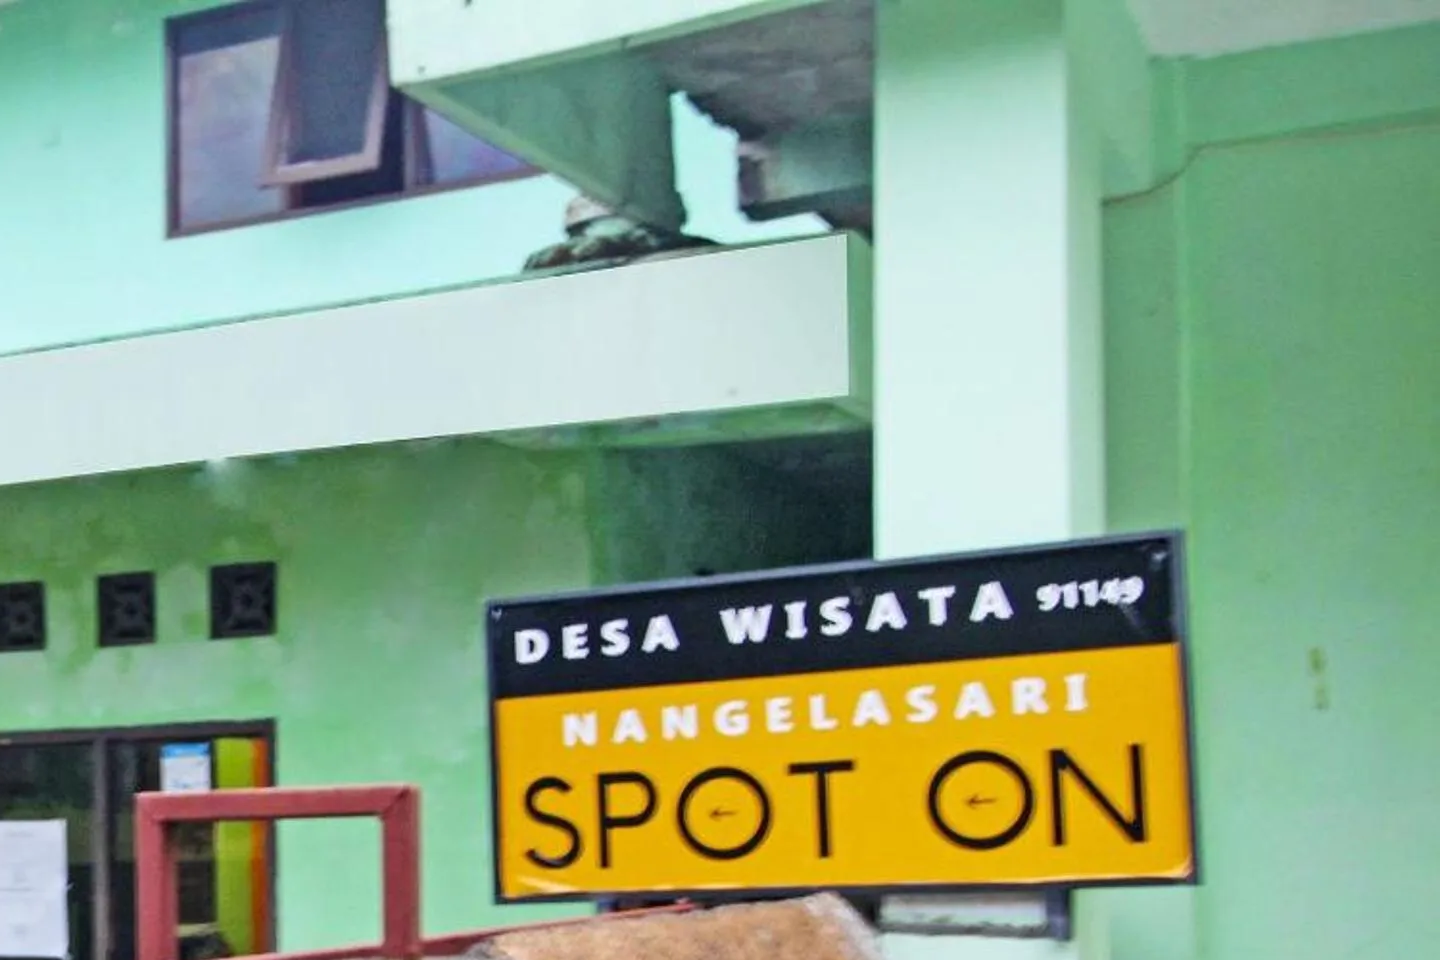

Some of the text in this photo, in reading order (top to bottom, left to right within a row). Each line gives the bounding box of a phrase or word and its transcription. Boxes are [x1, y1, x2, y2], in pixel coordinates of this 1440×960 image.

[514, 575, 1145, 664] DESA WISATA 91149
[563, 673, 1089, 747] NANGELASARI
[524, 744, 1149, 869] SPOT ON
